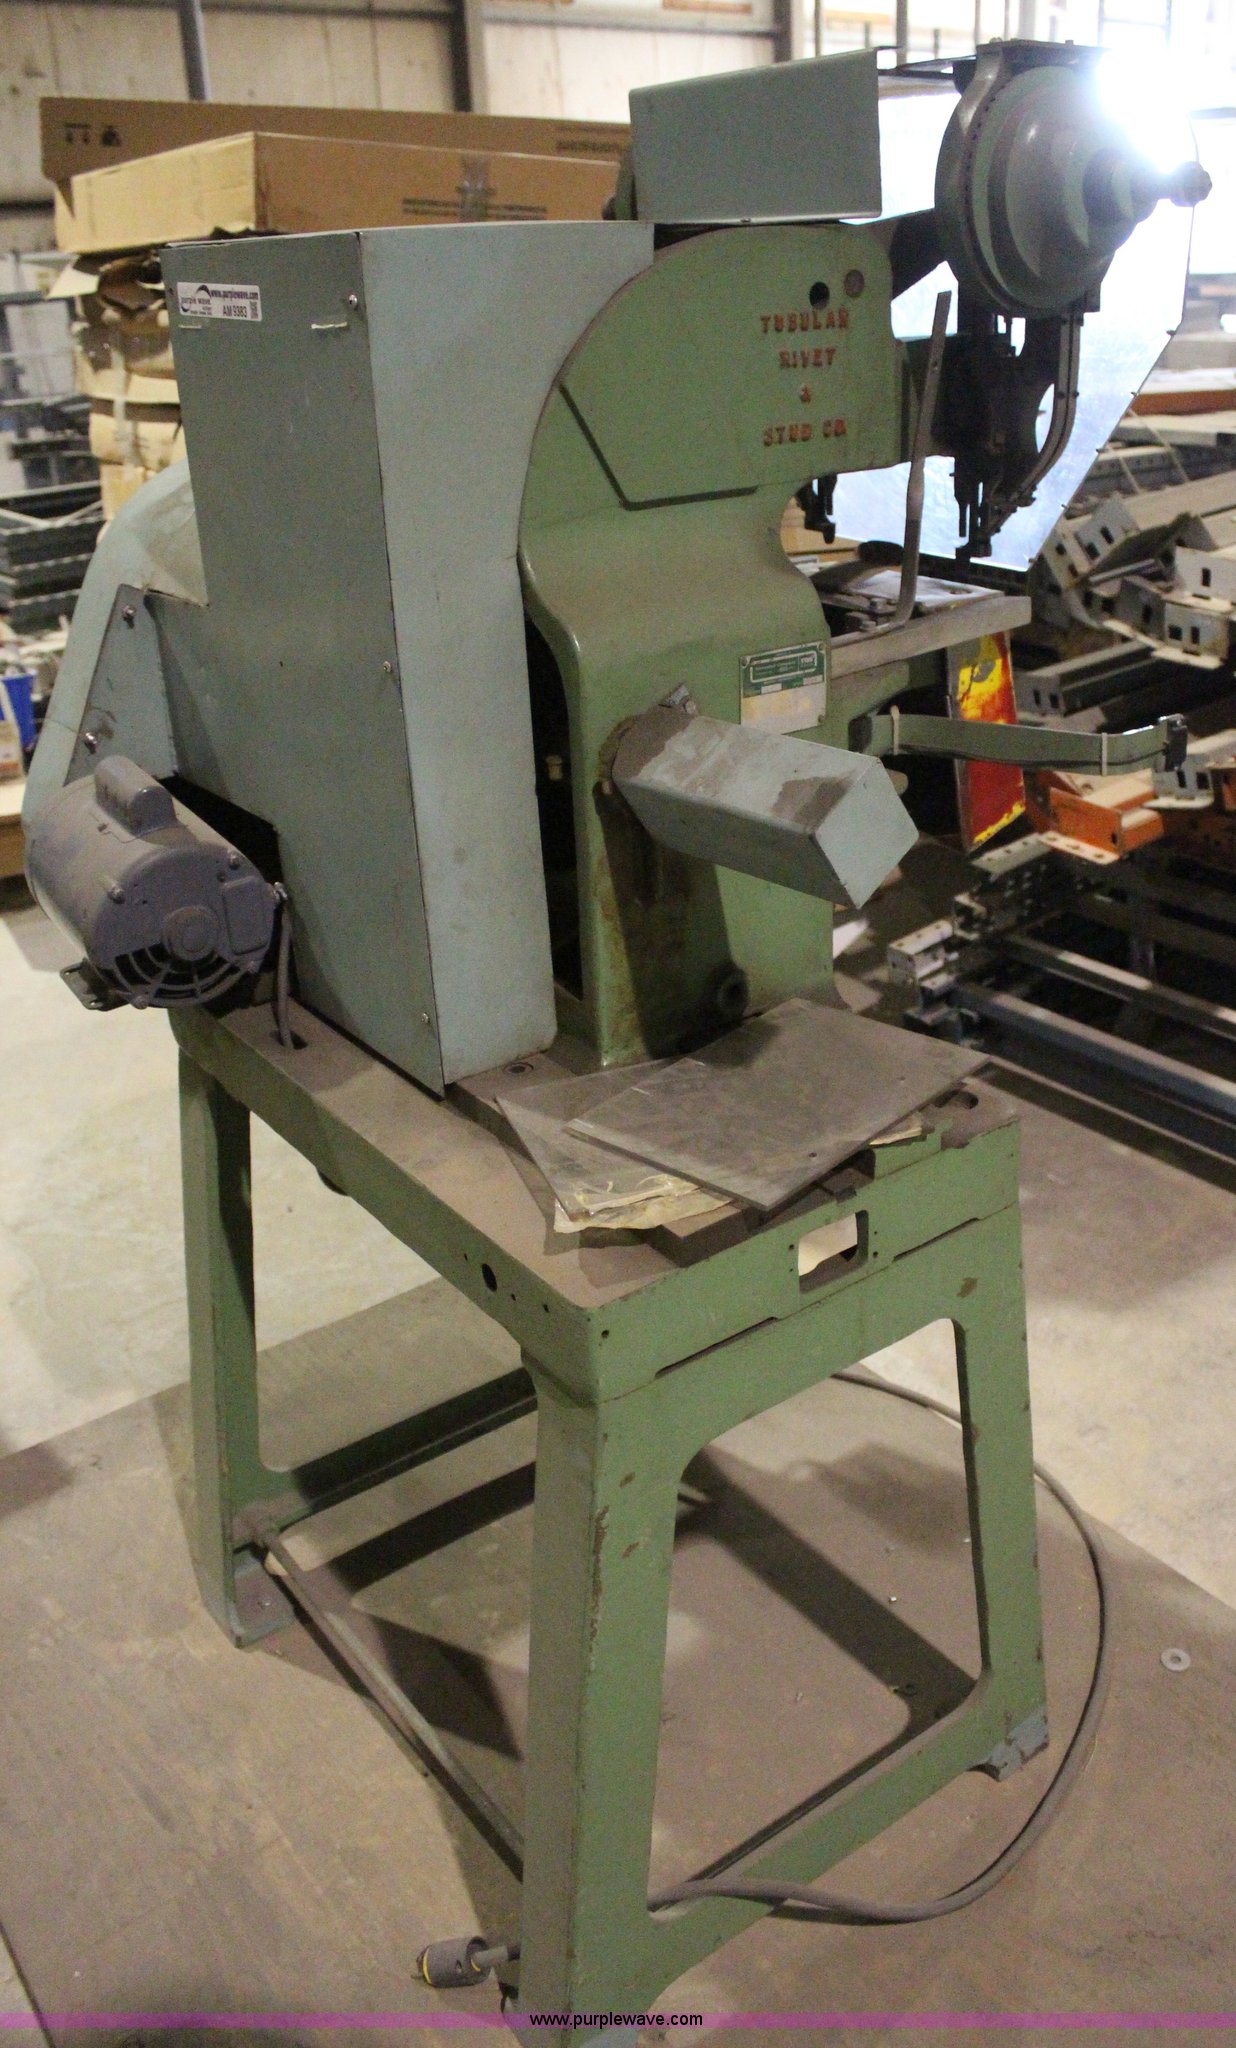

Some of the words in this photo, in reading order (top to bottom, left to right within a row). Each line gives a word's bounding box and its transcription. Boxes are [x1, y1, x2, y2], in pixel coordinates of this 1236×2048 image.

[760, 307, 849, 333] TUBULAR
[779, 346, 836, 368] RIVET
[763, 423, 812, 446] STUD
